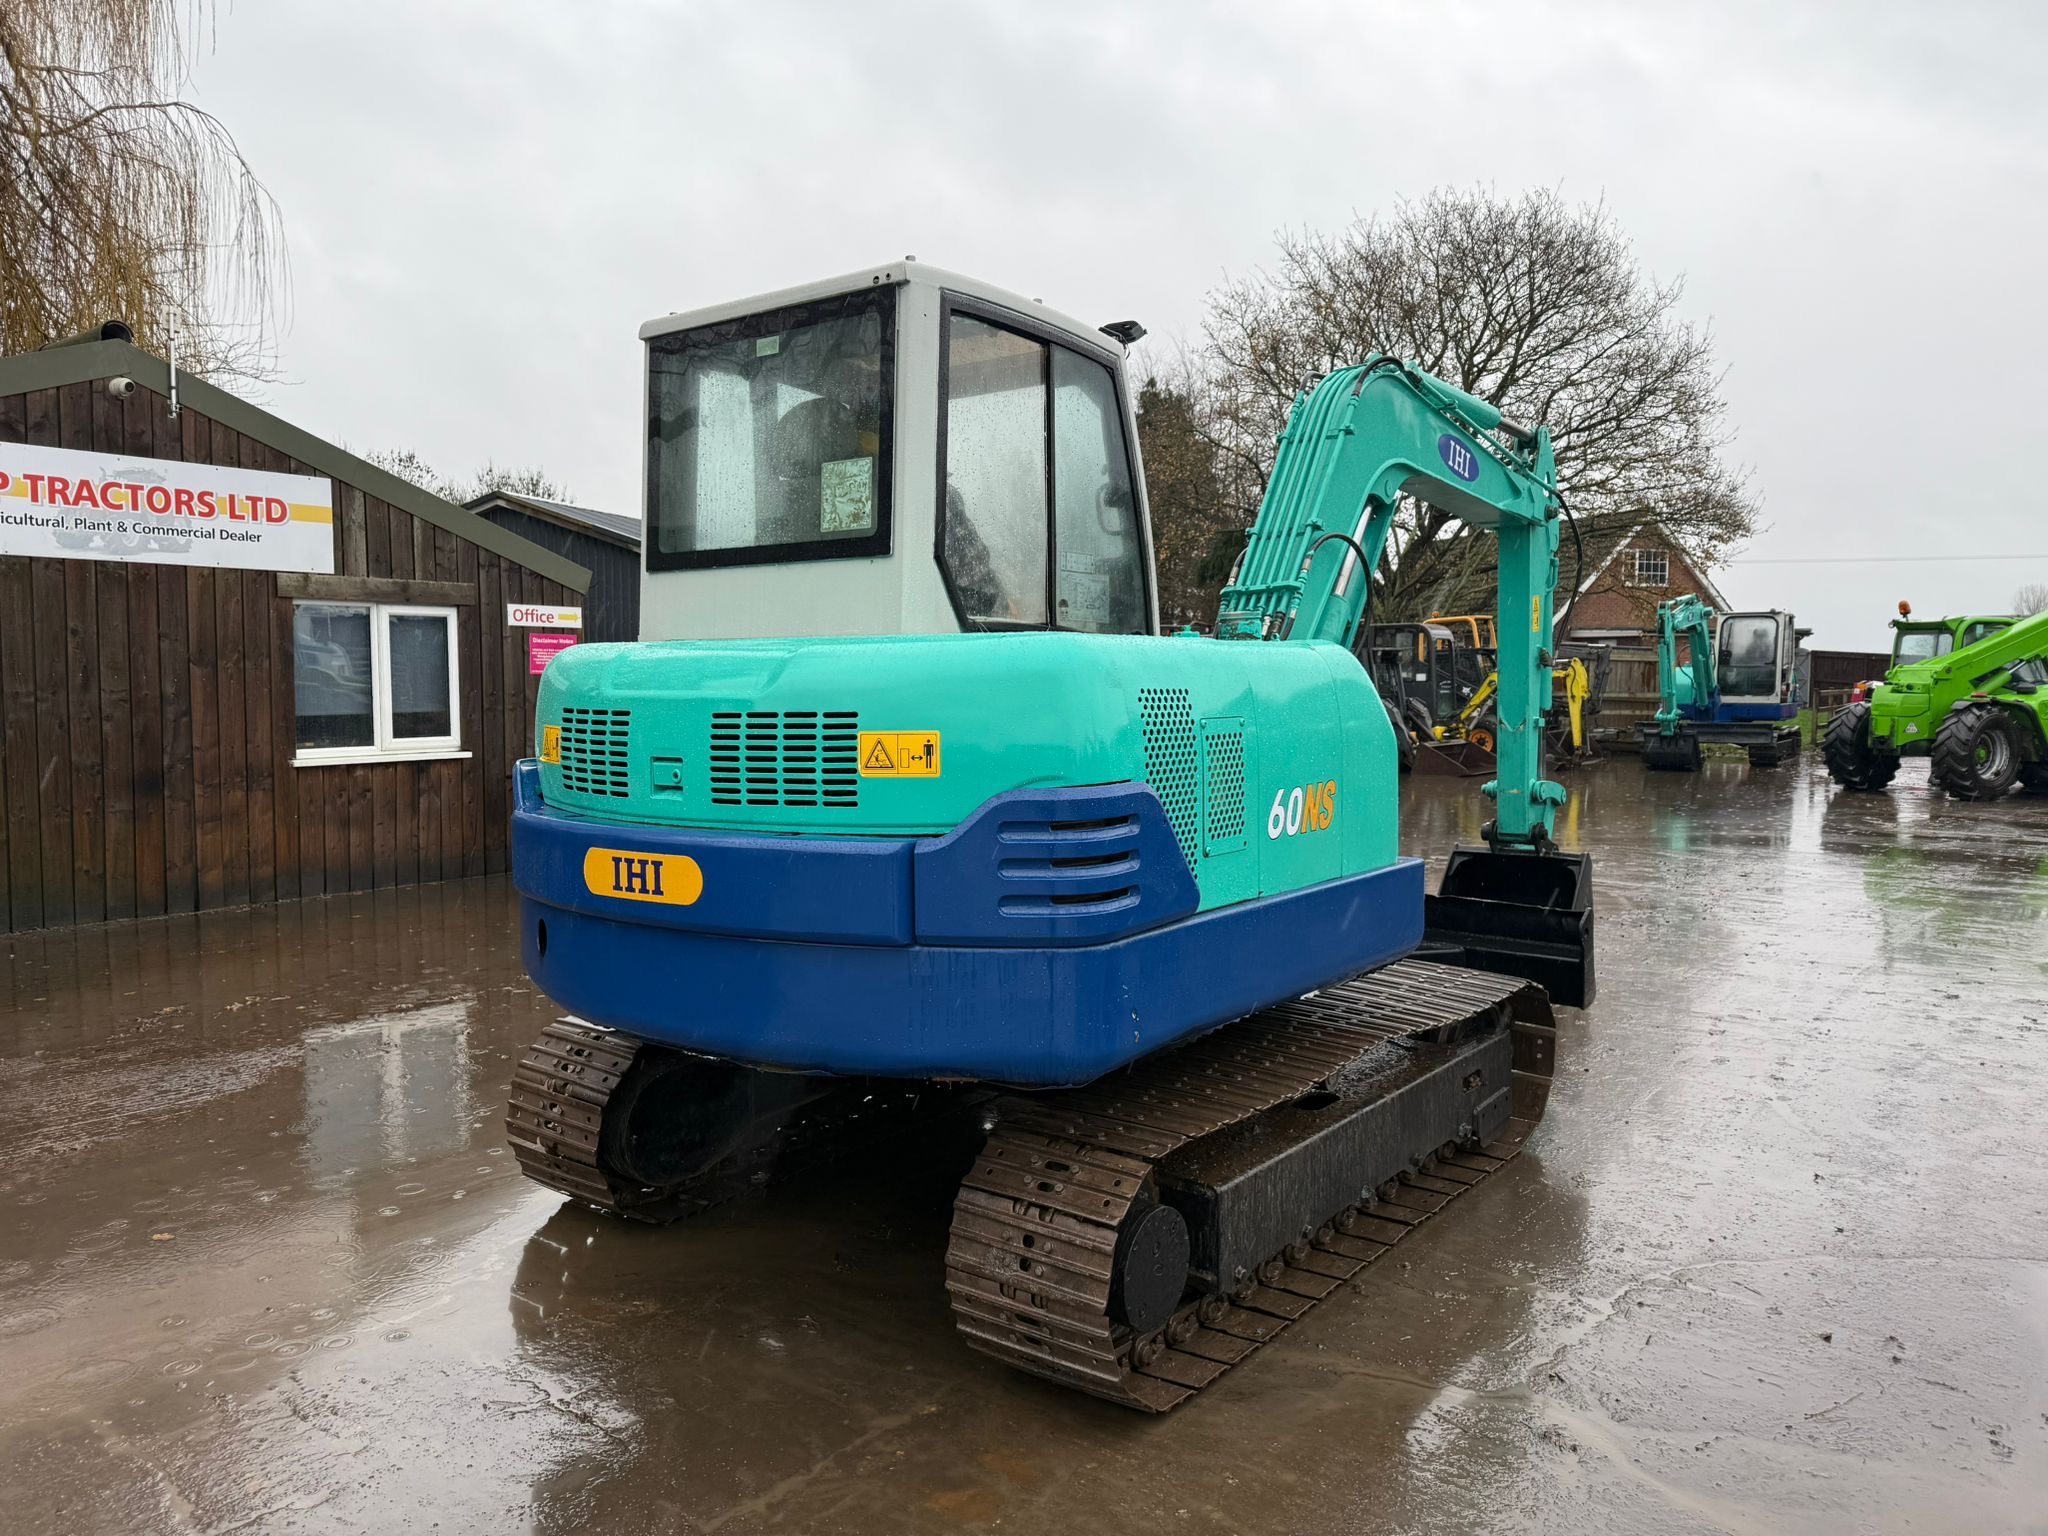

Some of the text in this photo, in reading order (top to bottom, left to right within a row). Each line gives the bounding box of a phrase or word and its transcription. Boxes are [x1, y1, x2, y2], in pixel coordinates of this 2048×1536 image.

[1447, 439, 1471, 479] IHI
[22, 473, 217, 519] TRACTORS
[228, 493, 289, 523] LTD
[0, 511, 262, 543] icultural, Plant & Commercial Dealer
[512, 608, 555, 624] Office
[1267, 779, 1337, 840] 60NS
[611, 855, 664, 897] IHI
